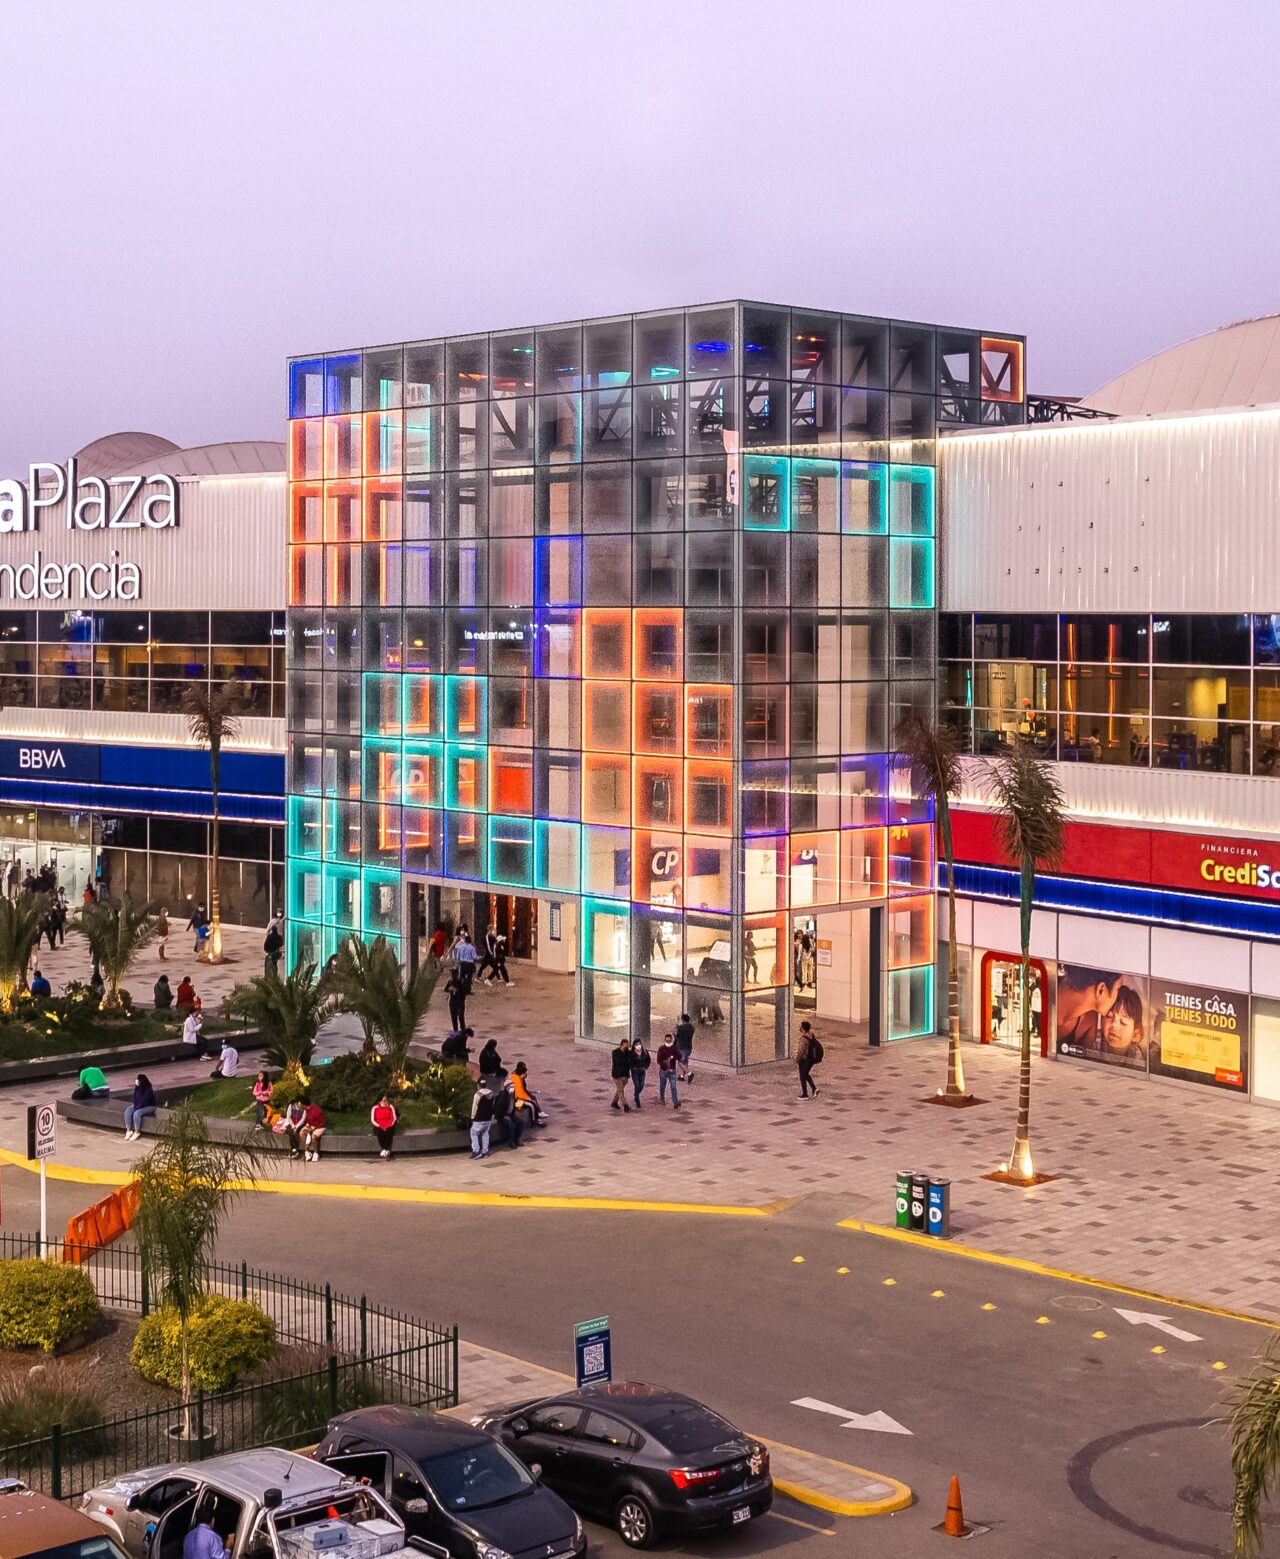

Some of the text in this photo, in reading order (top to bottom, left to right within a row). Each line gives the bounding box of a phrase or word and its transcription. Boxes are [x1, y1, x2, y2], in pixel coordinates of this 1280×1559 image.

[19, 748, 66, 769] BBVA
[1201, 843, 1259, 857] FINANCIERA
[1164, 992, 1202, 1010] TIENES
[1164, 1005, 1237, 1030] TIENES TODO
[41, 1113, 51, 1127] 10
